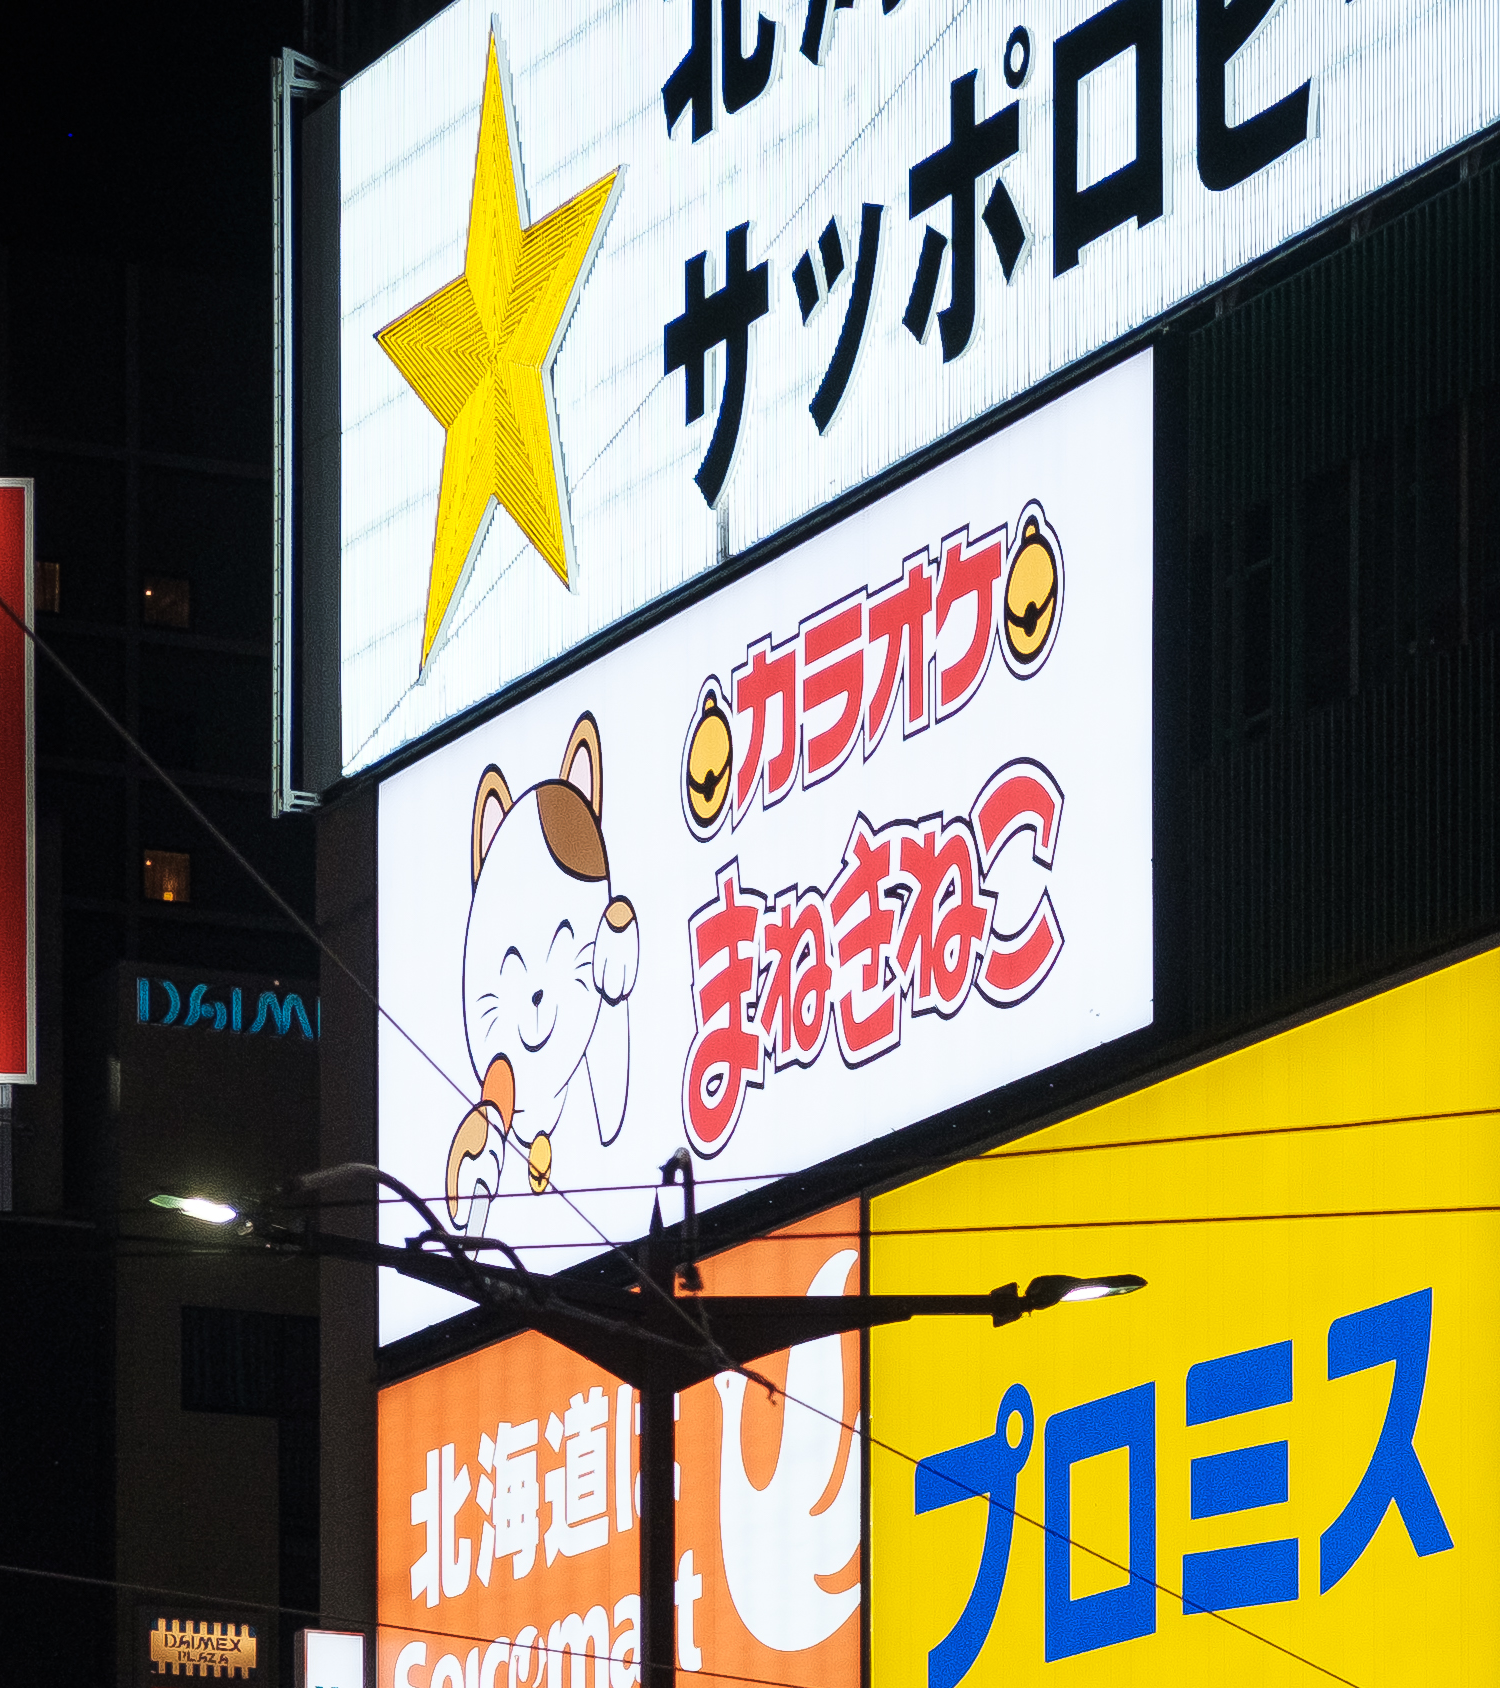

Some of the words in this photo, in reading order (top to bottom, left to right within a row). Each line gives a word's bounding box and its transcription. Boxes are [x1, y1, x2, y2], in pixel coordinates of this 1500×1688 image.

[733, 524, 1010, 828] カラオケ
[684, 757, 1065, 1158] まねきねこ
[165, 1634, 242, 1652] DAIMEX
[178, 1651, 229, 1664] PLAZA
